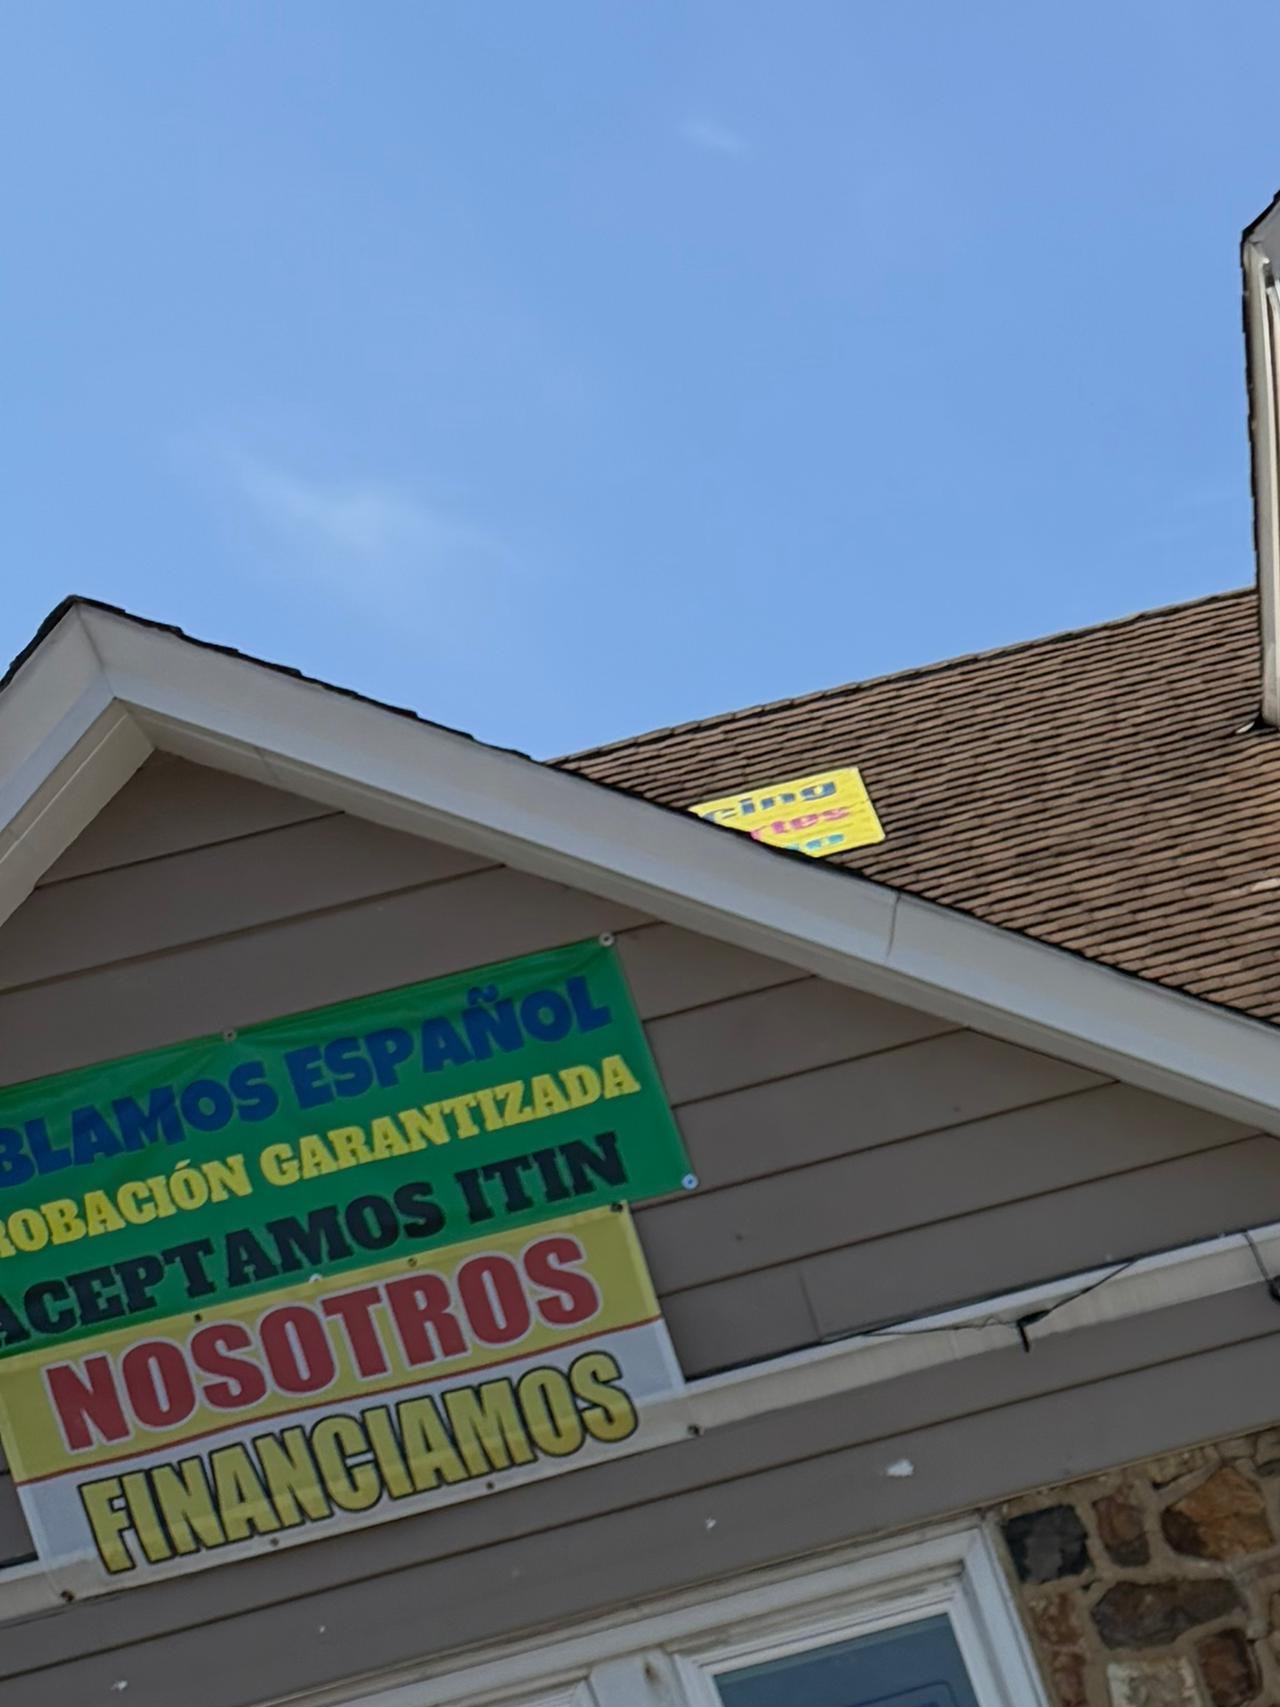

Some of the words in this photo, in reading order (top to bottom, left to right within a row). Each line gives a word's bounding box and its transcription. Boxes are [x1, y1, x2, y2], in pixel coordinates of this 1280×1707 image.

[282, 975, 613, 1110] ESPAÑOL
[258, 1053, 641, 1187] GARANTIZADA
[455, 1130, 630, 1223] ITIN
[46, 1236, 602, 1452] NOSOTROS
[79, 1350, 640, 1575] FINANCIAMOS
